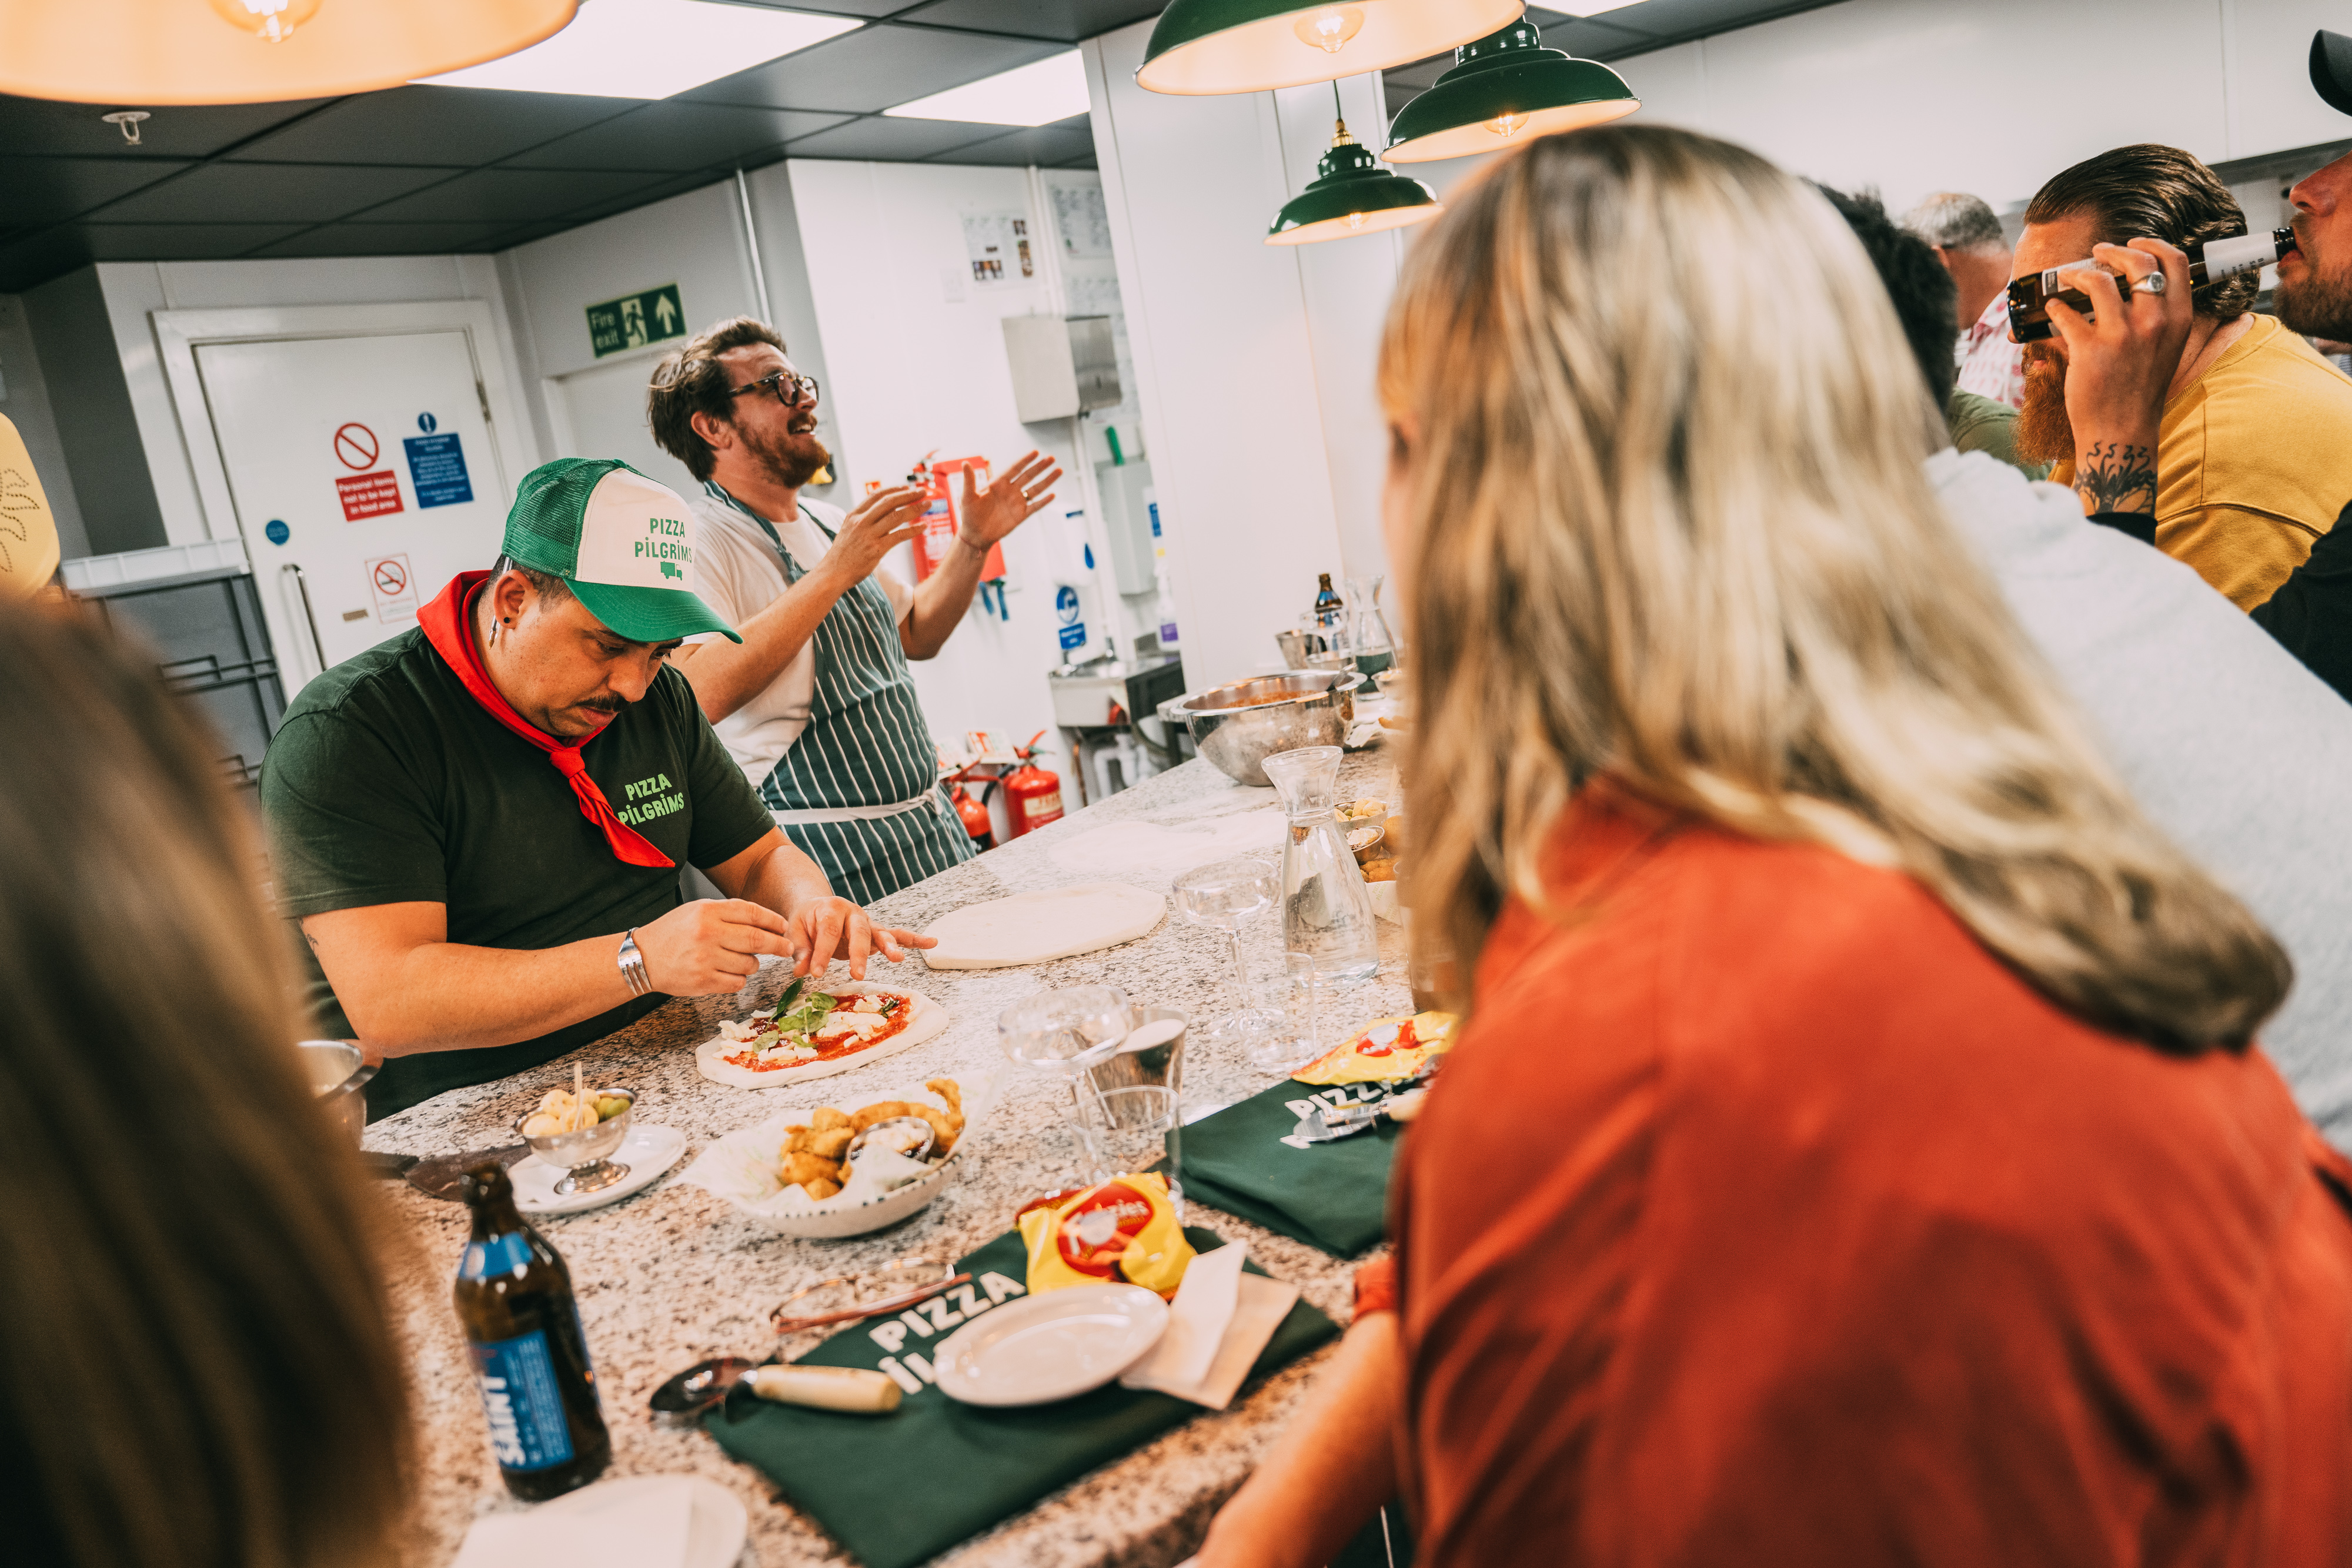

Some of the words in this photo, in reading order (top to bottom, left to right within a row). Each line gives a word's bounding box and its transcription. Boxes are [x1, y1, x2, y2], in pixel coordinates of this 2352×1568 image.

[590, 312, 615, 329] Fire
[596, 329, 619, 349] exit
[338, 479, 373, 492] Personal
[343, 493, 358, 504] not
[358, 493, 368, 502] to
[368, 490, 378, 500] be
[379, 486, 396, 498] kept
[350, 506, 360, 515] in
[360, 500, 379, 513] food
[379, 499, 397, 510] area
[649, 517, 685, 538] PIZZA
[624, 773, 672, 801] PIZZA
[868, 1271, 1027, 1353] PIZZA
